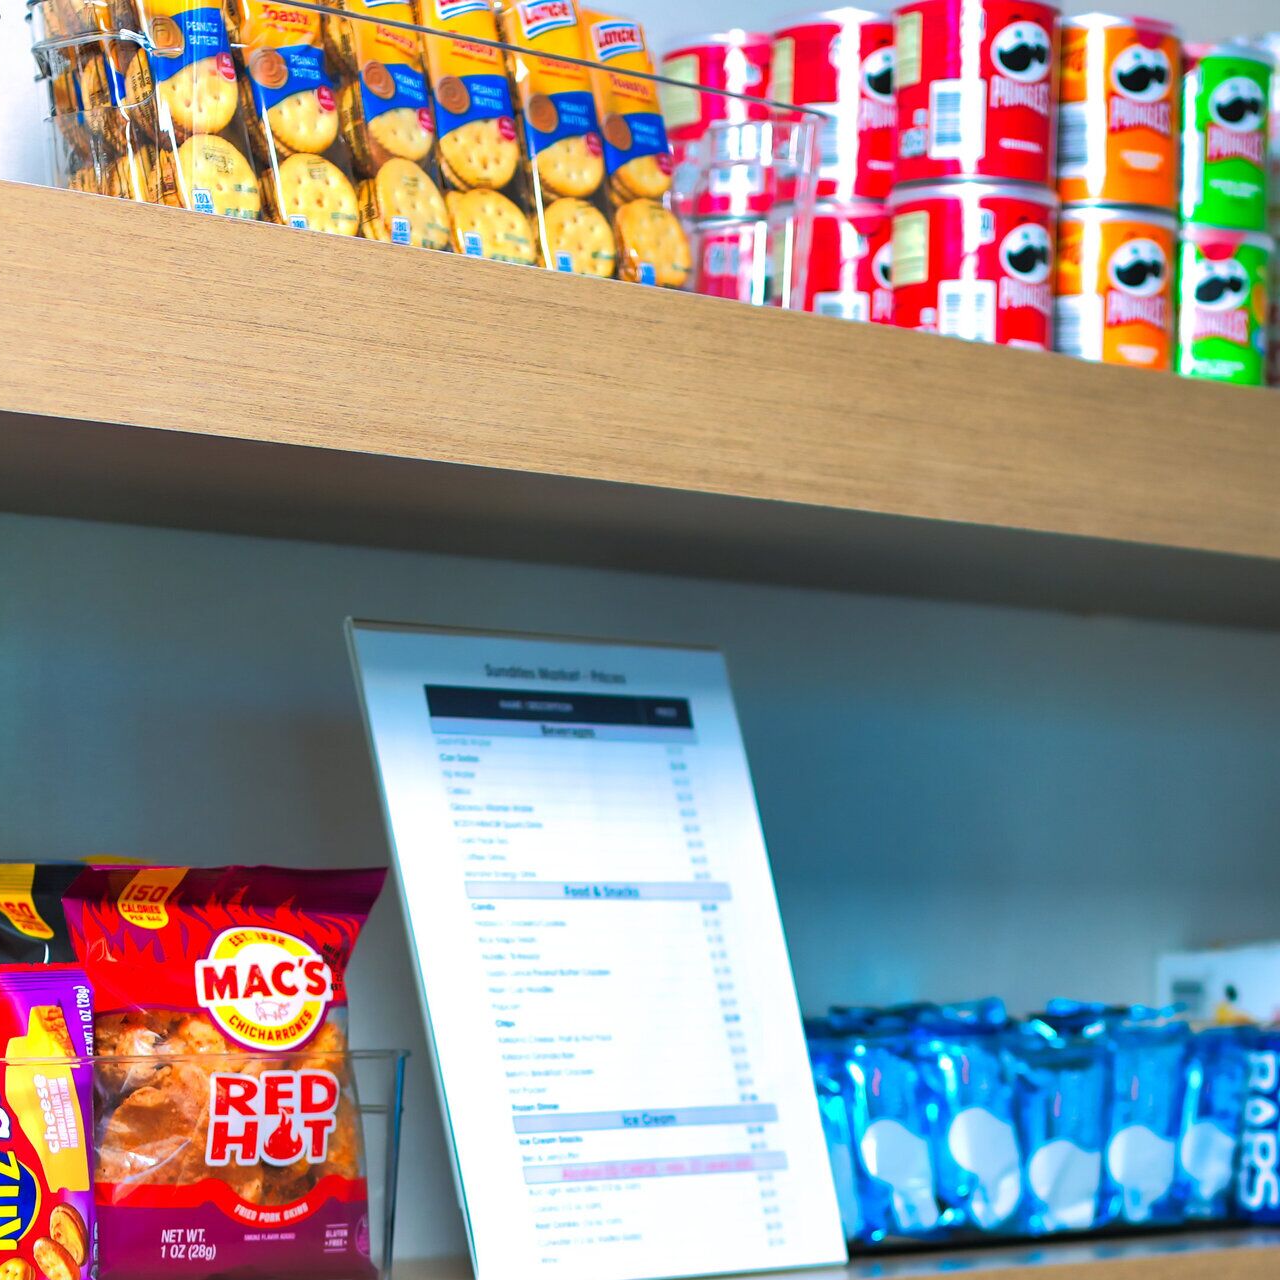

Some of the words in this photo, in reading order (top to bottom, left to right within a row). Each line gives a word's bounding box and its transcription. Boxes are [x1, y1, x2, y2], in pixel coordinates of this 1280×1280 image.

[125, 884, 167, 901] 150
[120, 902, 161, 915] CALORIES
[201, 957, 327, 1001] MAC'S
[73, 985, 90, 1008] (28g)
[79, 1009, 92, 1021] OZ
[228, 1010, 314, 1042] CHICHARRONES
[213, 1073, 338, 1117] RED
[33, 1073, 60, 1154] cheese
[161, 1229, 183, 1243] NET
[186, 1228, 206, 1243] WT.
[169, 1245, 185, 1259] OZ
[187, 1243, 217, 1260] (28g)
